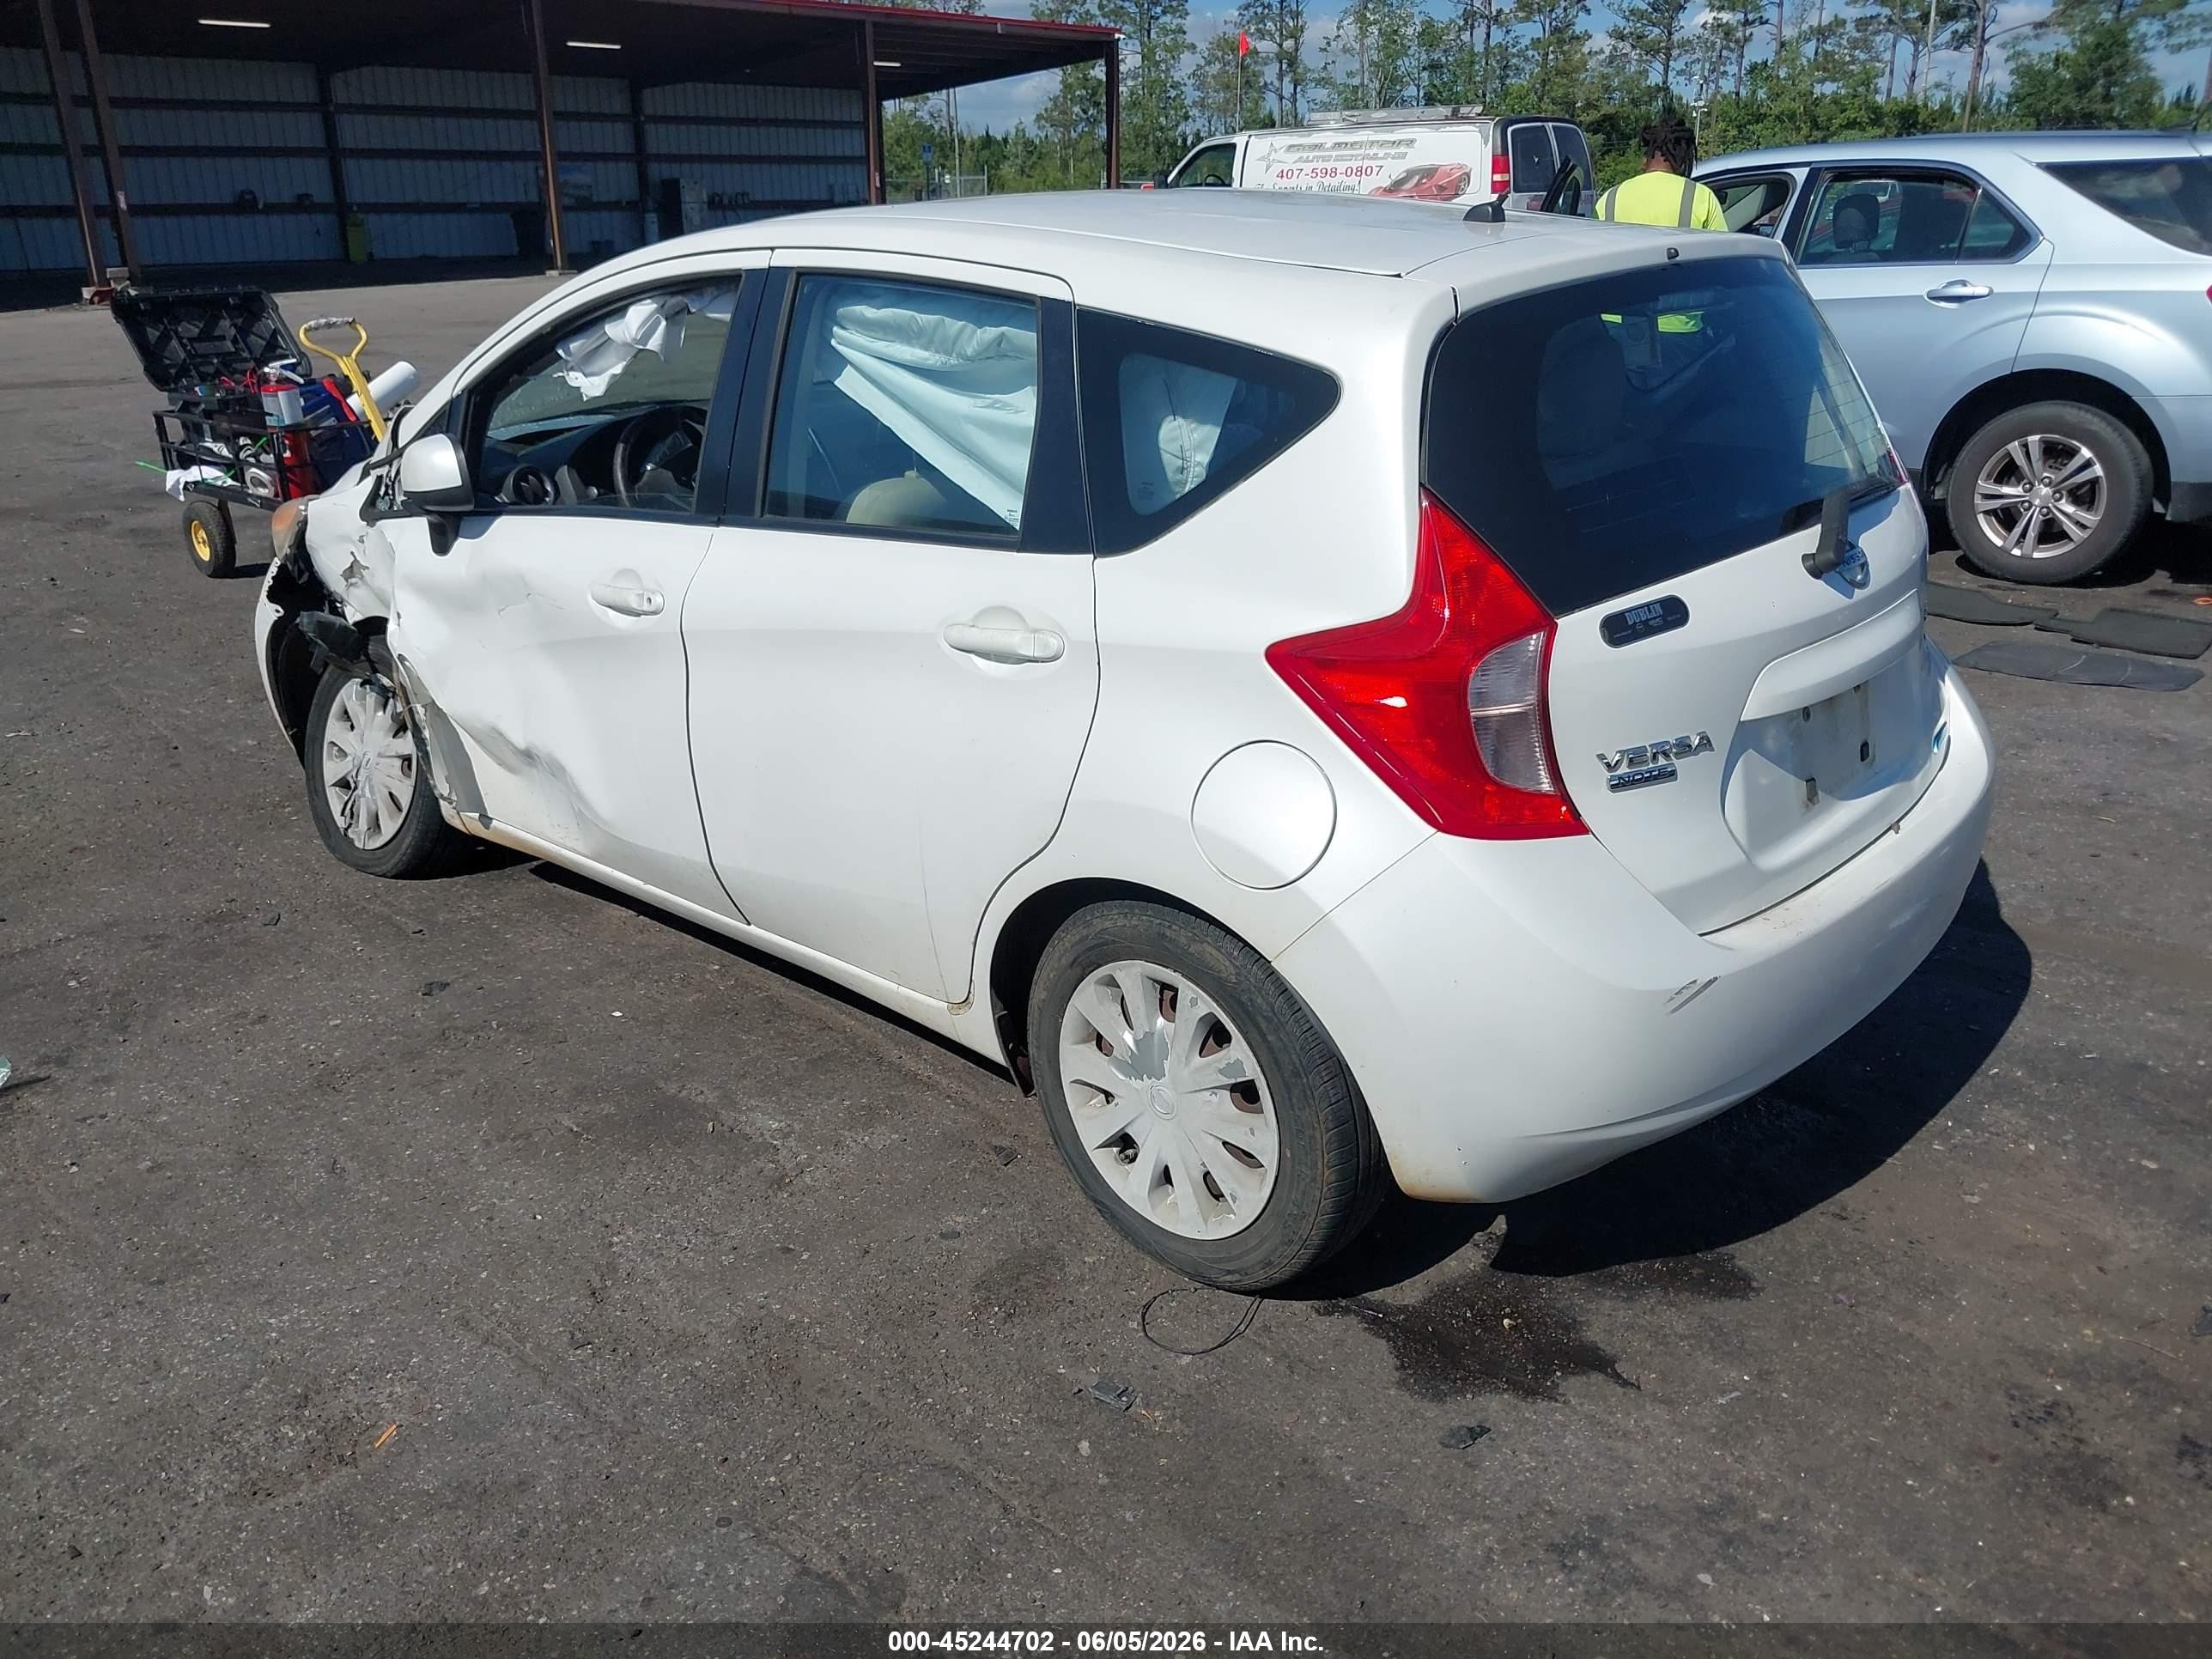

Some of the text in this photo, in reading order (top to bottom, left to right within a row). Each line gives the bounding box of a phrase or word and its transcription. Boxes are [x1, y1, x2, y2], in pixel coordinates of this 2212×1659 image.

[1276, 165, 1384, 179] 407-598-0807
[1624, 603, 1663, 625] DUBLIN
[1595, 730, 1716, 774] VERSA
[1617, 767, 1669, 787] NOTE
